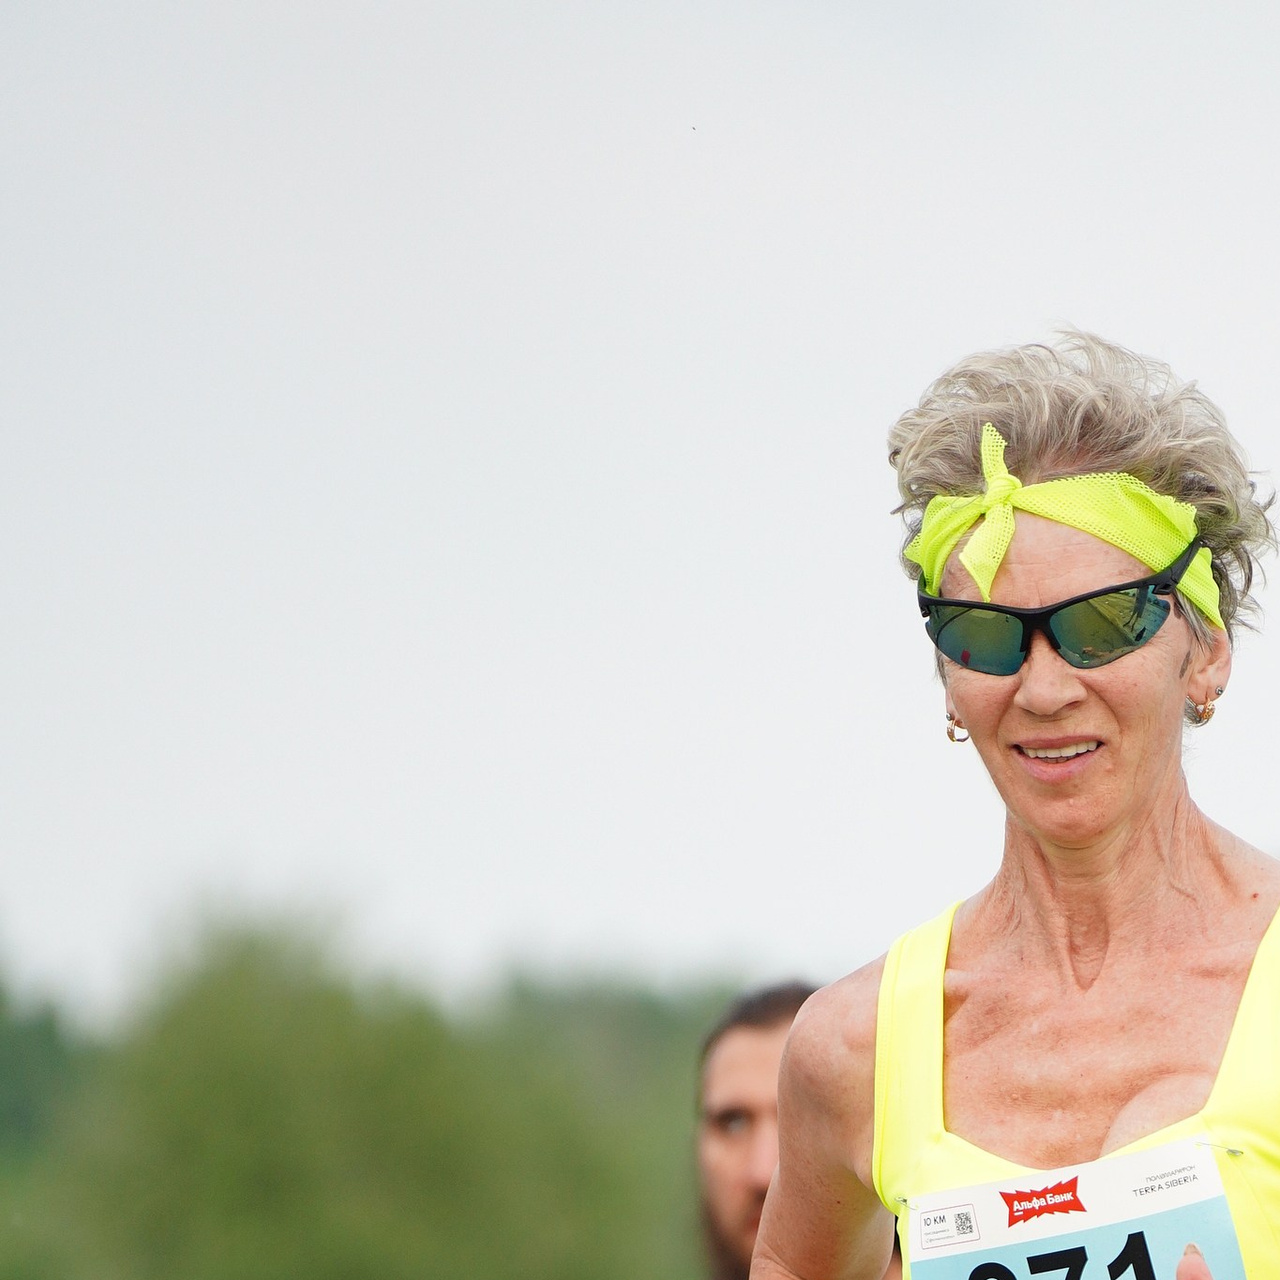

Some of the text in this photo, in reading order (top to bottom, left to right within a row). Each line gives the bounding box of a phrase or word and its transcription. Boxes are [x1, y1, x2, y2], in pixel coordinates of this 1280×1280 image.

[1132, 1174, 1199, 1197] TERRA SIBERIA
[1013, 1191, 1075, 1214] Альфа Банк
[923, 1217, 932, 1227] 10
